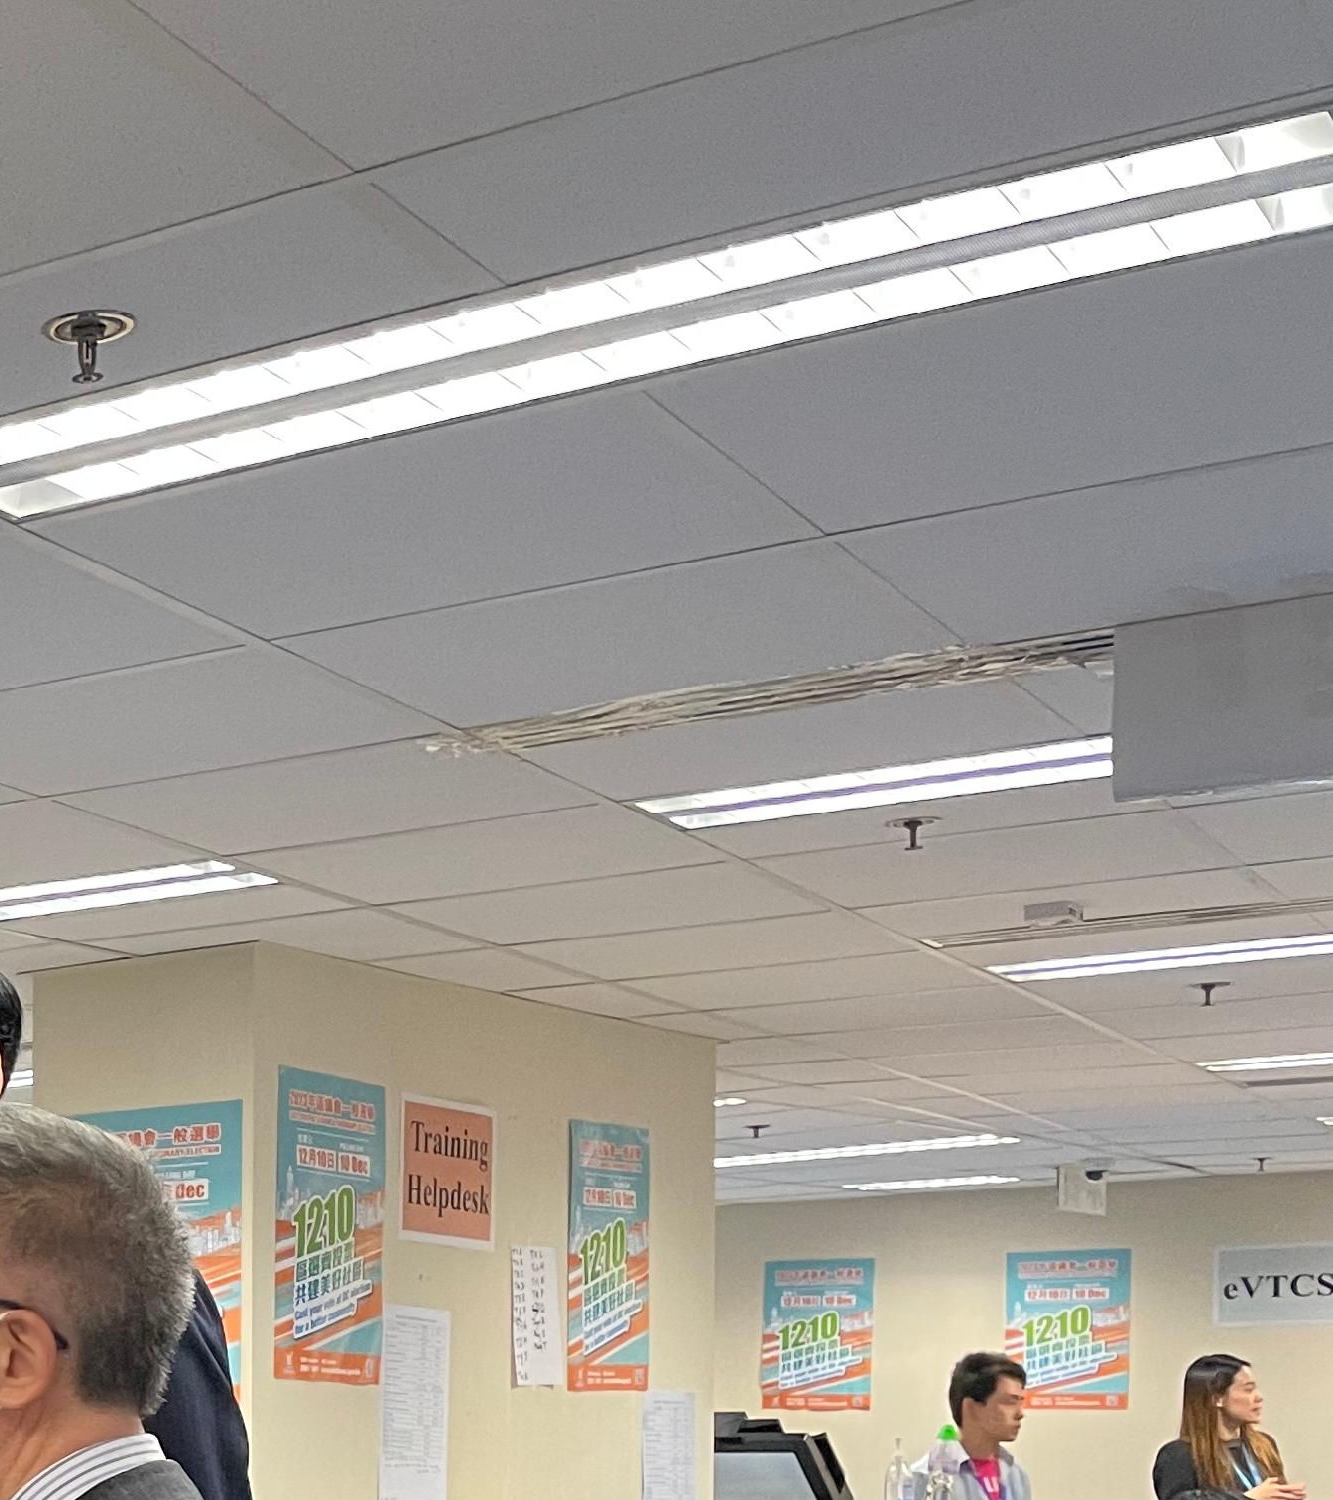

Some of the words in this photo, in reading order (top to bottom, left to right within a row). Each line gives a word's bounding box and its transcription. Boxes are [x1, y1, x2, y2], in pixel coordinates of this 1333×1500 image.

[411, 1120, 489, 1172] Training
[408, 1173, 490, 1218] Helpdesk
[294, 1187, 355, 1259] 1210
[580, 1219, 625, 1286] 1210
[1223, 1272, 1333, 1300] eVTCS
[779, 1312, 839, 1350] 1210
[1023, 1307, 1090, 1347] 1210
